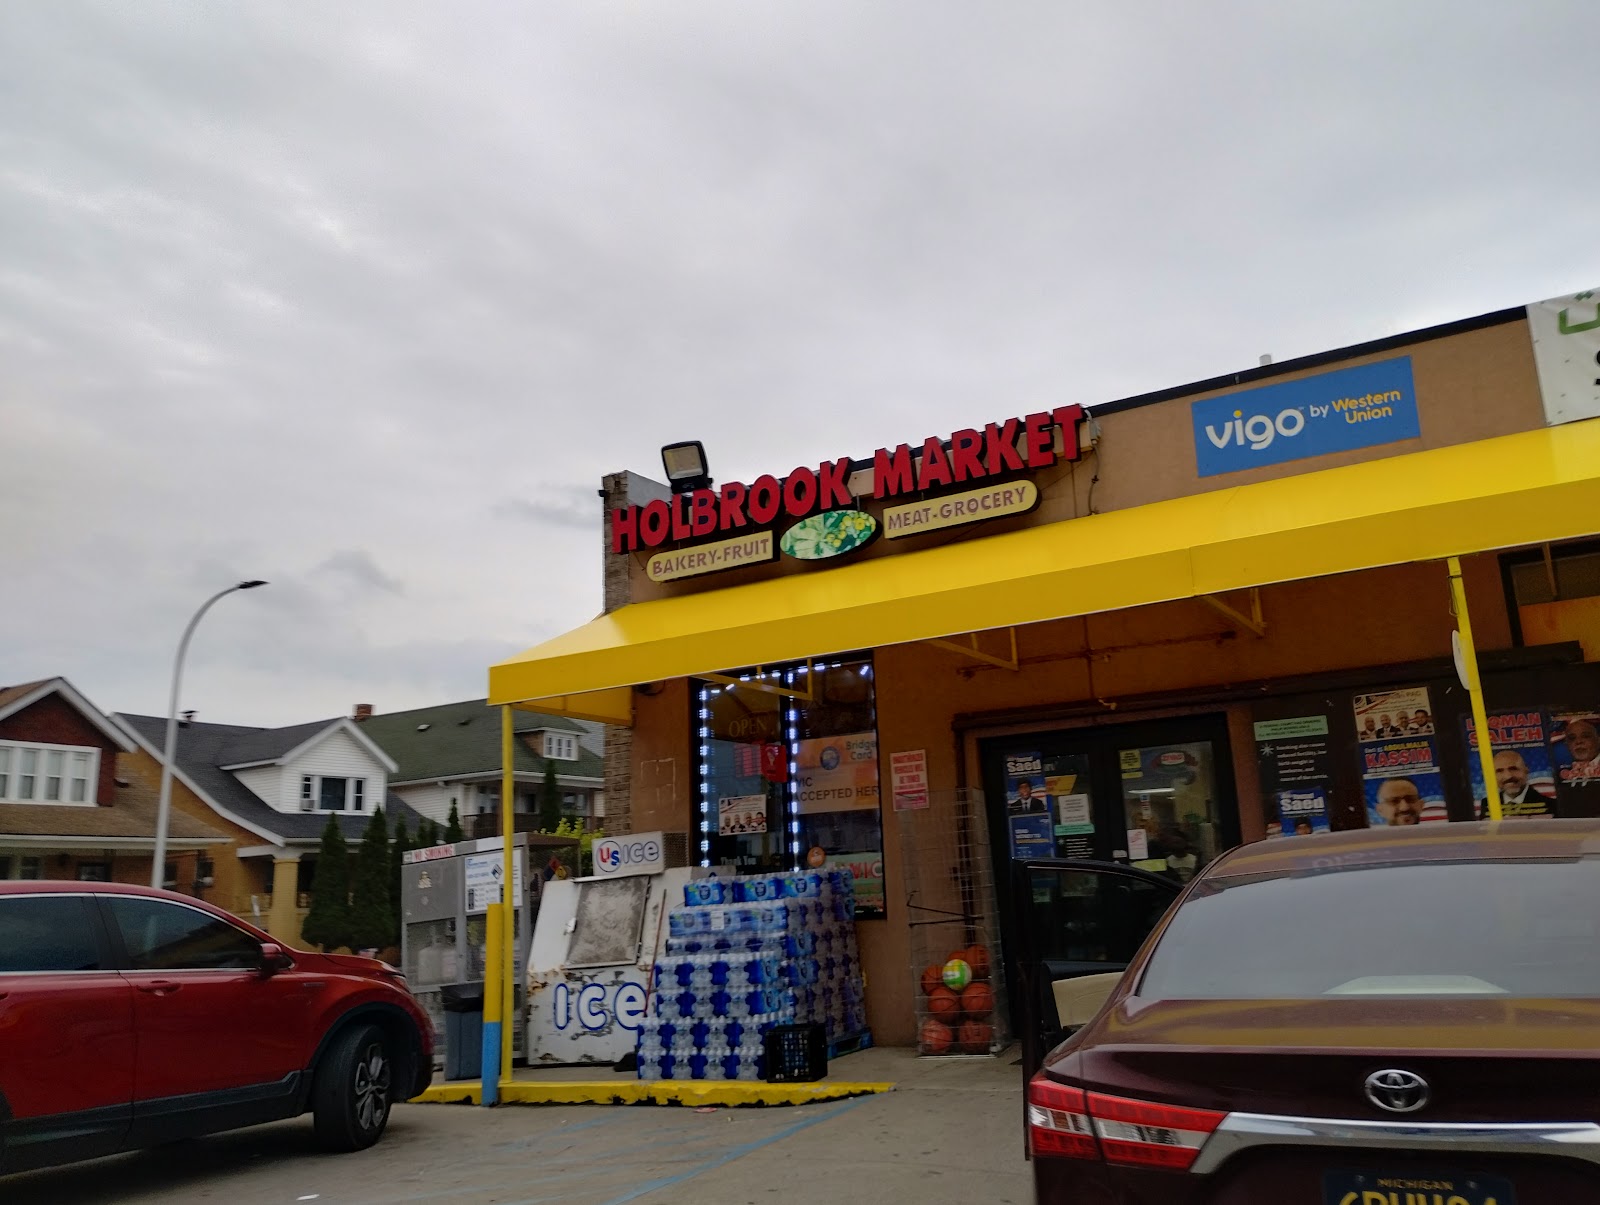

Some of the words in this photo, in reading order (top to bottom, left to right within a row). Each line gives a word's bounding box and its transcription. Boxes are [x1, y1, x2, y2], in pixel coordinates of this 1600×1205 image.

[1205, 409, 1304, 451] vigo
[1309, 404, 1329, 419] by
[1331, 390, 1401, 412] Western
[1345, 406, 1392, 424] Union
[611, 457, 852, 554] HOLBROOK
[873, 403, 1083, 499] MARKET
[888, 486, 1026, 529] MEAT-GROCERY
[652, 538, 770, 575] BAKERY-FRUIT
[729, 716, 767, 738] OPEN
[1466, 712, 1541, 731] LQMAN
[851, 749, 872, 761] Card
[1364, 747, 1433, 768] KASSIM
[1007, 759, 1042, 773] Saed
[1280, 796, 1325, 811] Saed
[1376, 1177, 1455, 1191] MICHIGAN
